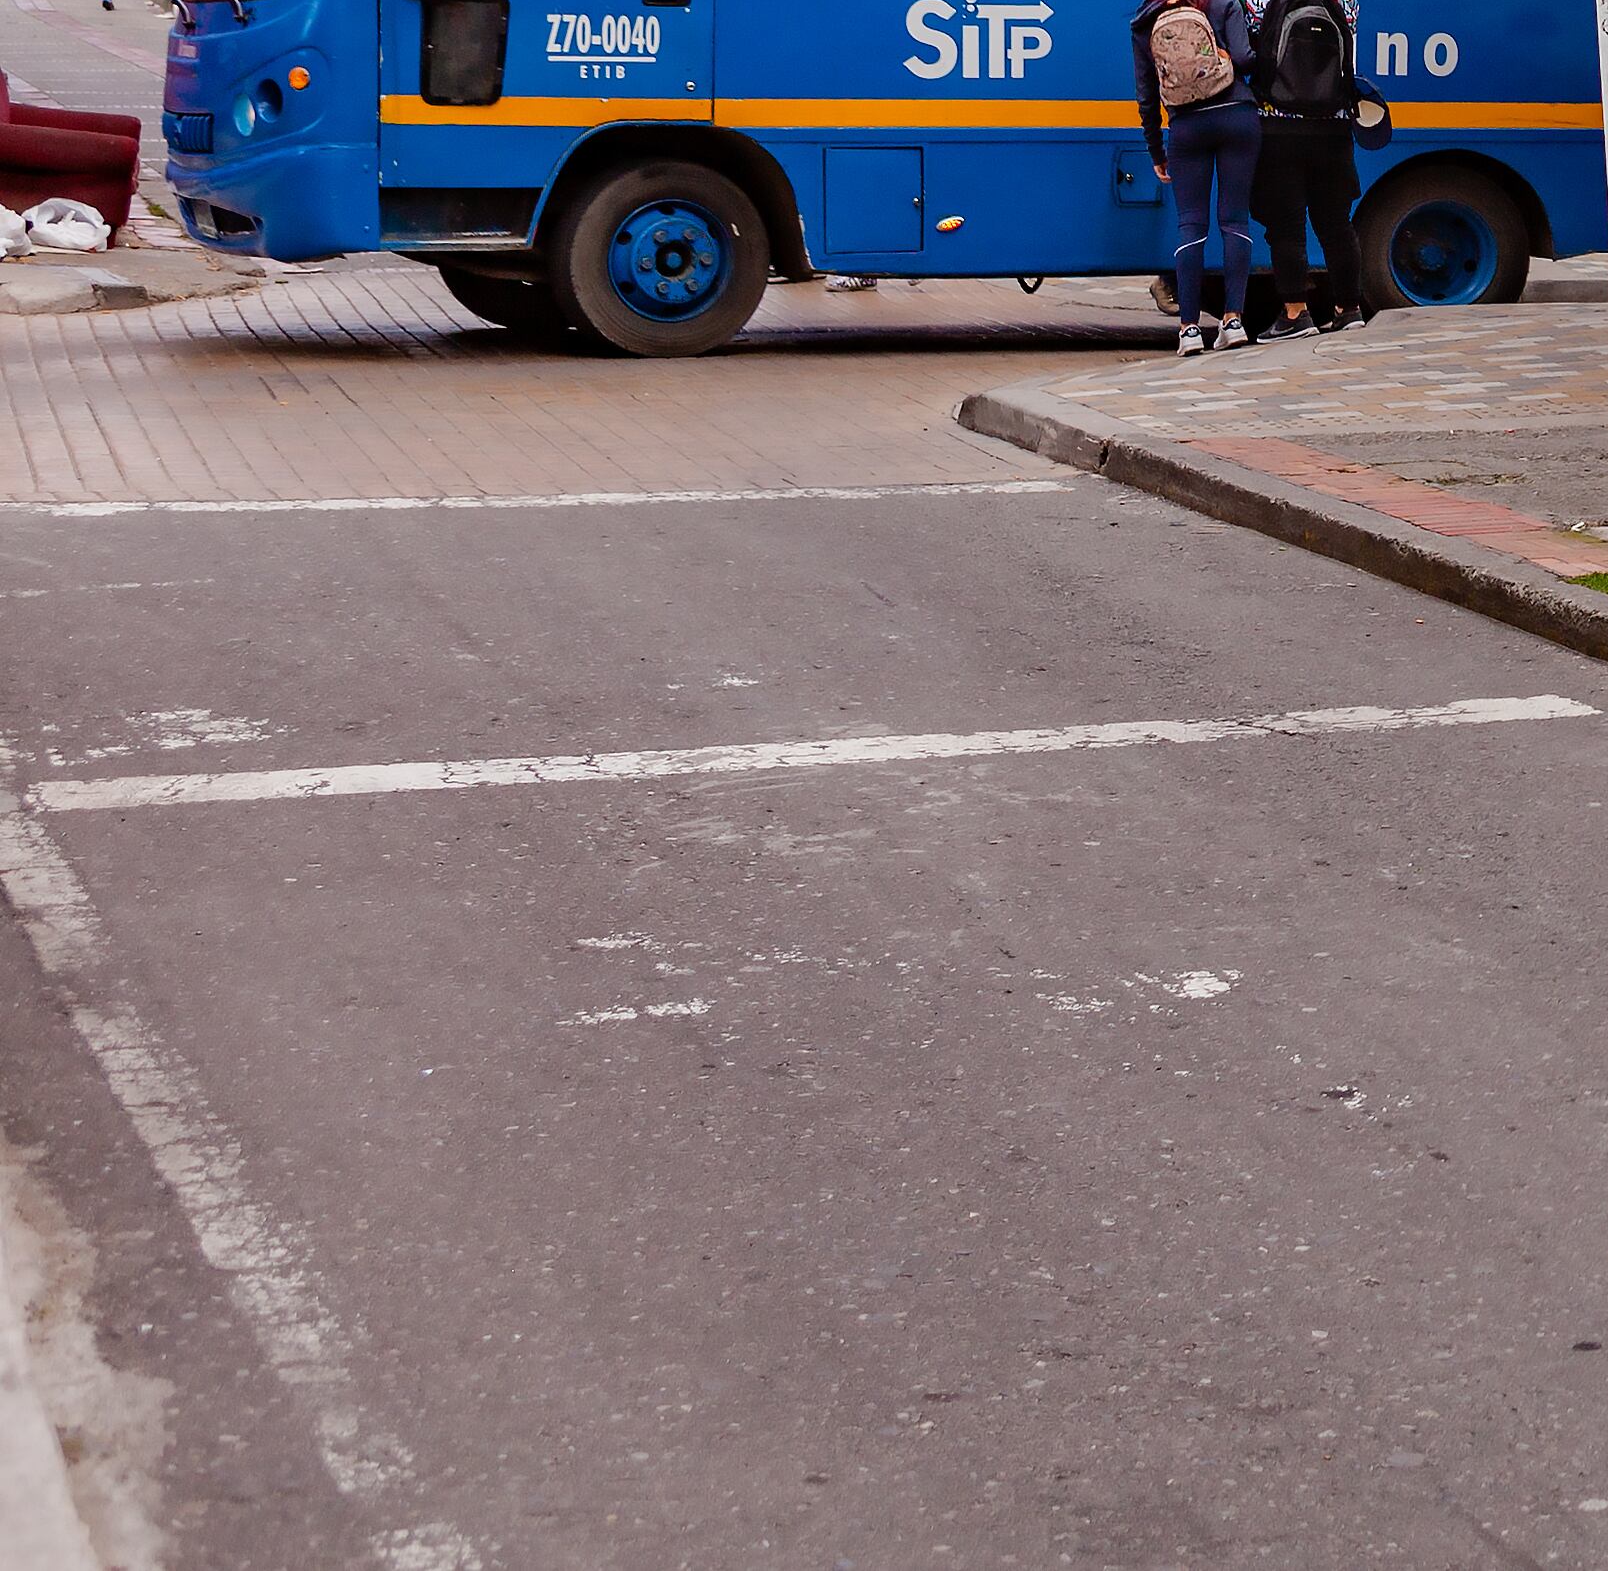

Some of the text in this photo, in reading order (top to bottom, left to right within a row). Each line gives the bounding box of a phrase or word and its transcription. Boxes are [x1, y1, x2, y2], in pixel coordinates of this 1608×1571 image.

[546, 13, 661, 54] Z70-0040
[579, 65, 626, 79] ETIB
[1376, 32, 1459, 77] no
